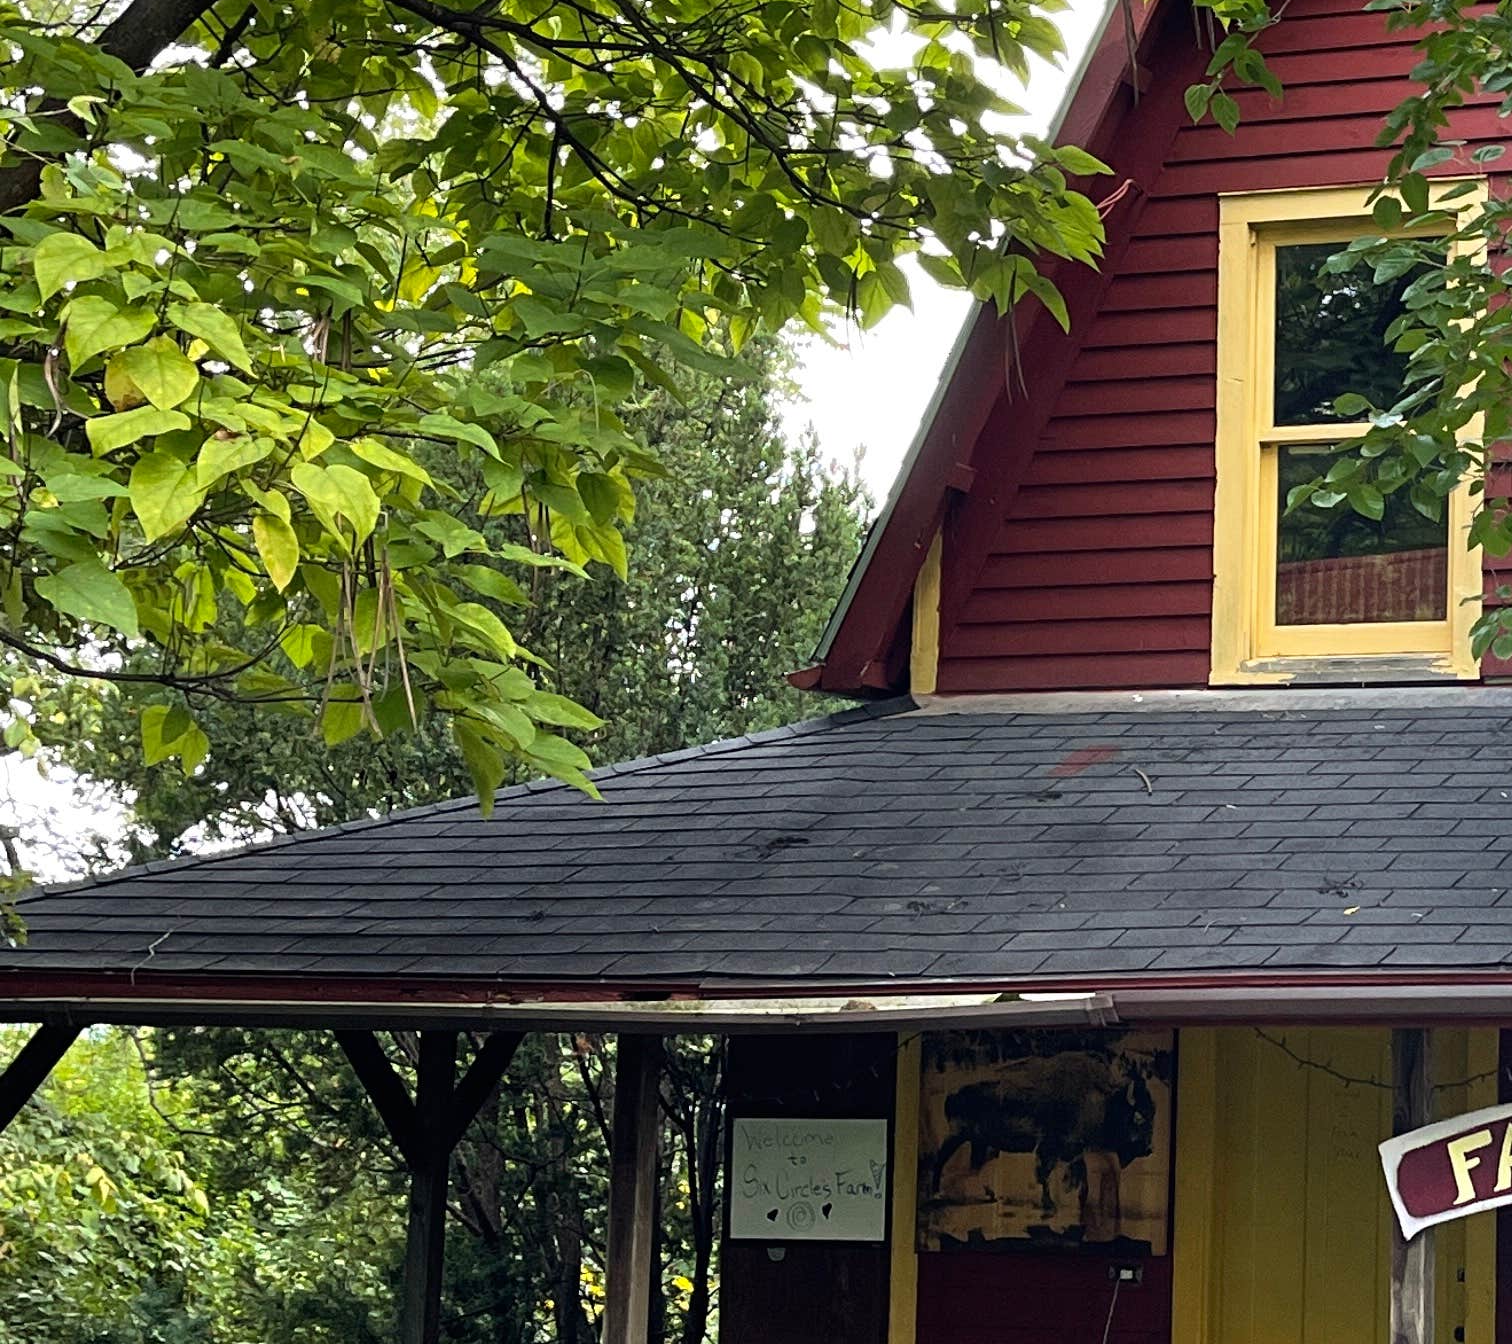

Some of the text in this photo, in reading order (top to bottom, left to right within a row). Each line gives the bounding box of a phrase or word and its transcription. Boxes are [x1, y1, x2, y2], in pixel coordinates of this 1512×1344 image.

[740, 1124, 834, 1151] Welcome
[787, 1153, 808, 1167] to
[742, 1164, 771, 1199] Six
